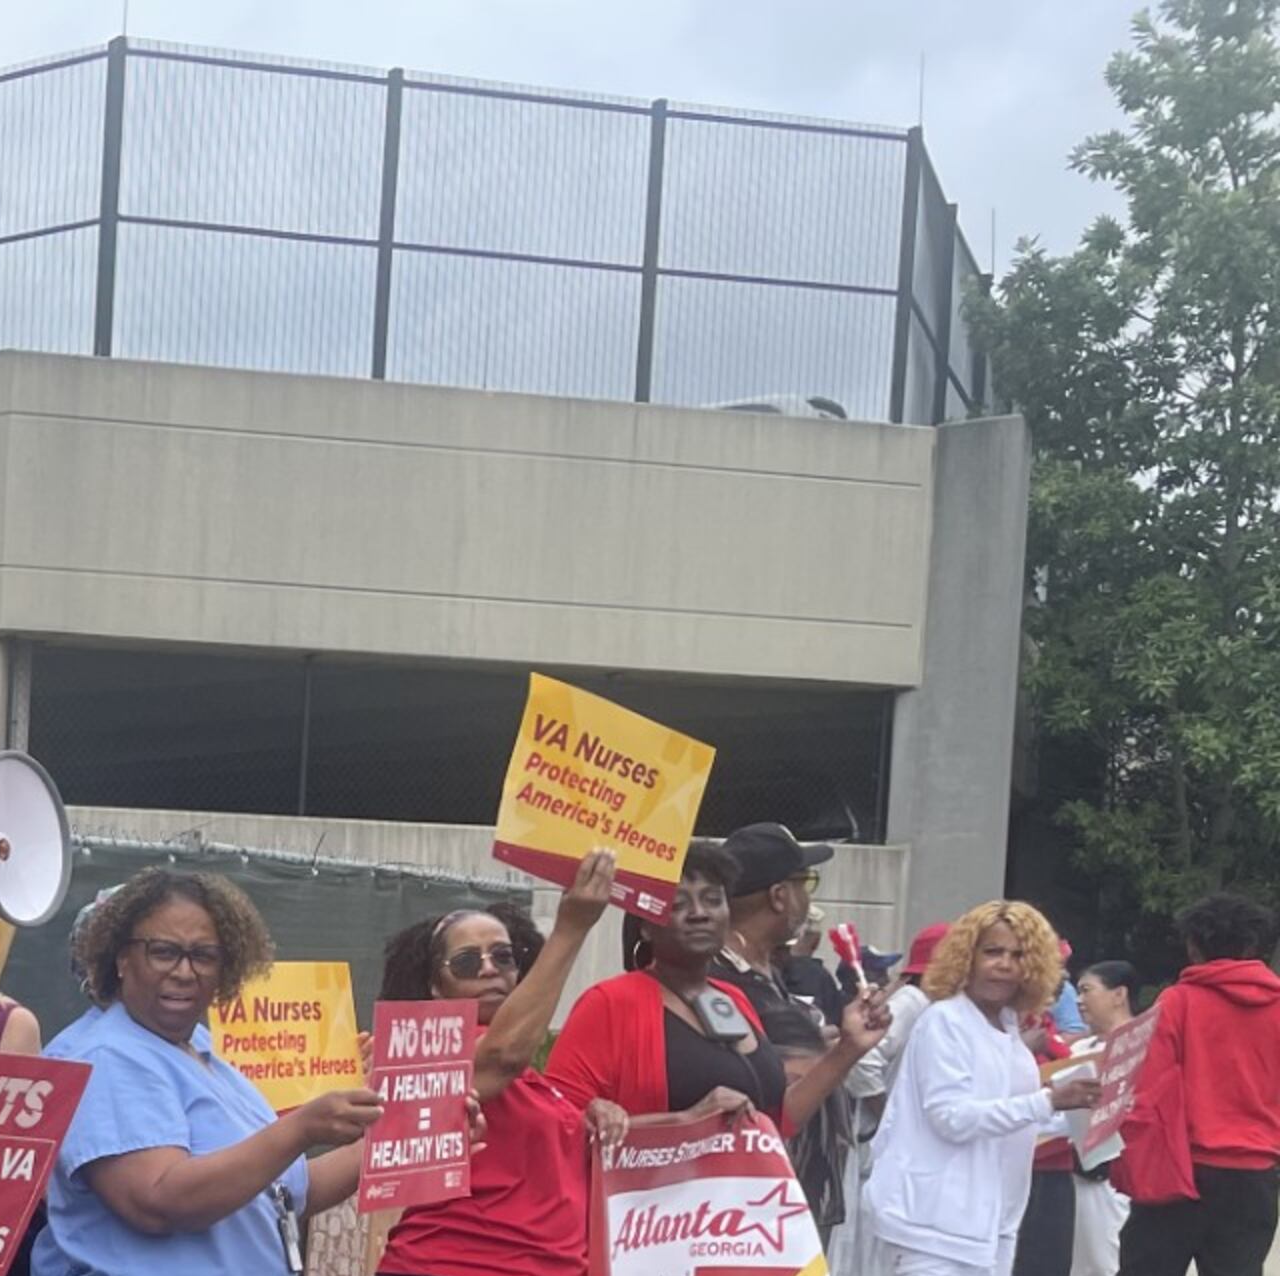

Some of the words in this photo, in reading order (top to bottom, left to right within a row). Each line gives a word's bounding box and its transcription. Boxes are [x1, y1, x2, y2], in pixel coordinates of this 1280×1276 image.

[533, 714, 569, 751] VA
[574, 732, 660, 788] Nurses
[525, 752, 626, 812] Protecting
[516, 782, 613, 835] America's
[614, 820, 677, 862] Heroes
[217, 998, 247, 1024] VA
[253, 997, 322, 1023] Nurses
[222, 1030, 306, 1054] Protecting
[387, 1019, 419, 1059] NO
[421, 1015, 465, 1056] CUTS
[309, 1056, 357, 1077] Heroes
[378, 1076, 389, 1101] A
[393, 1071, 449, 1102] HEALTHY
[450, 1070, 465, 1096] VA
[1, 1147, 36, 1181] VA
[370, 1136, 434, 1169] HEALTHY
[434, 1132, 464, 1161] VETS
[612, 1200, 746, 1259] Atlanta
[691, 1242, 765, 1257] GEORGIA
